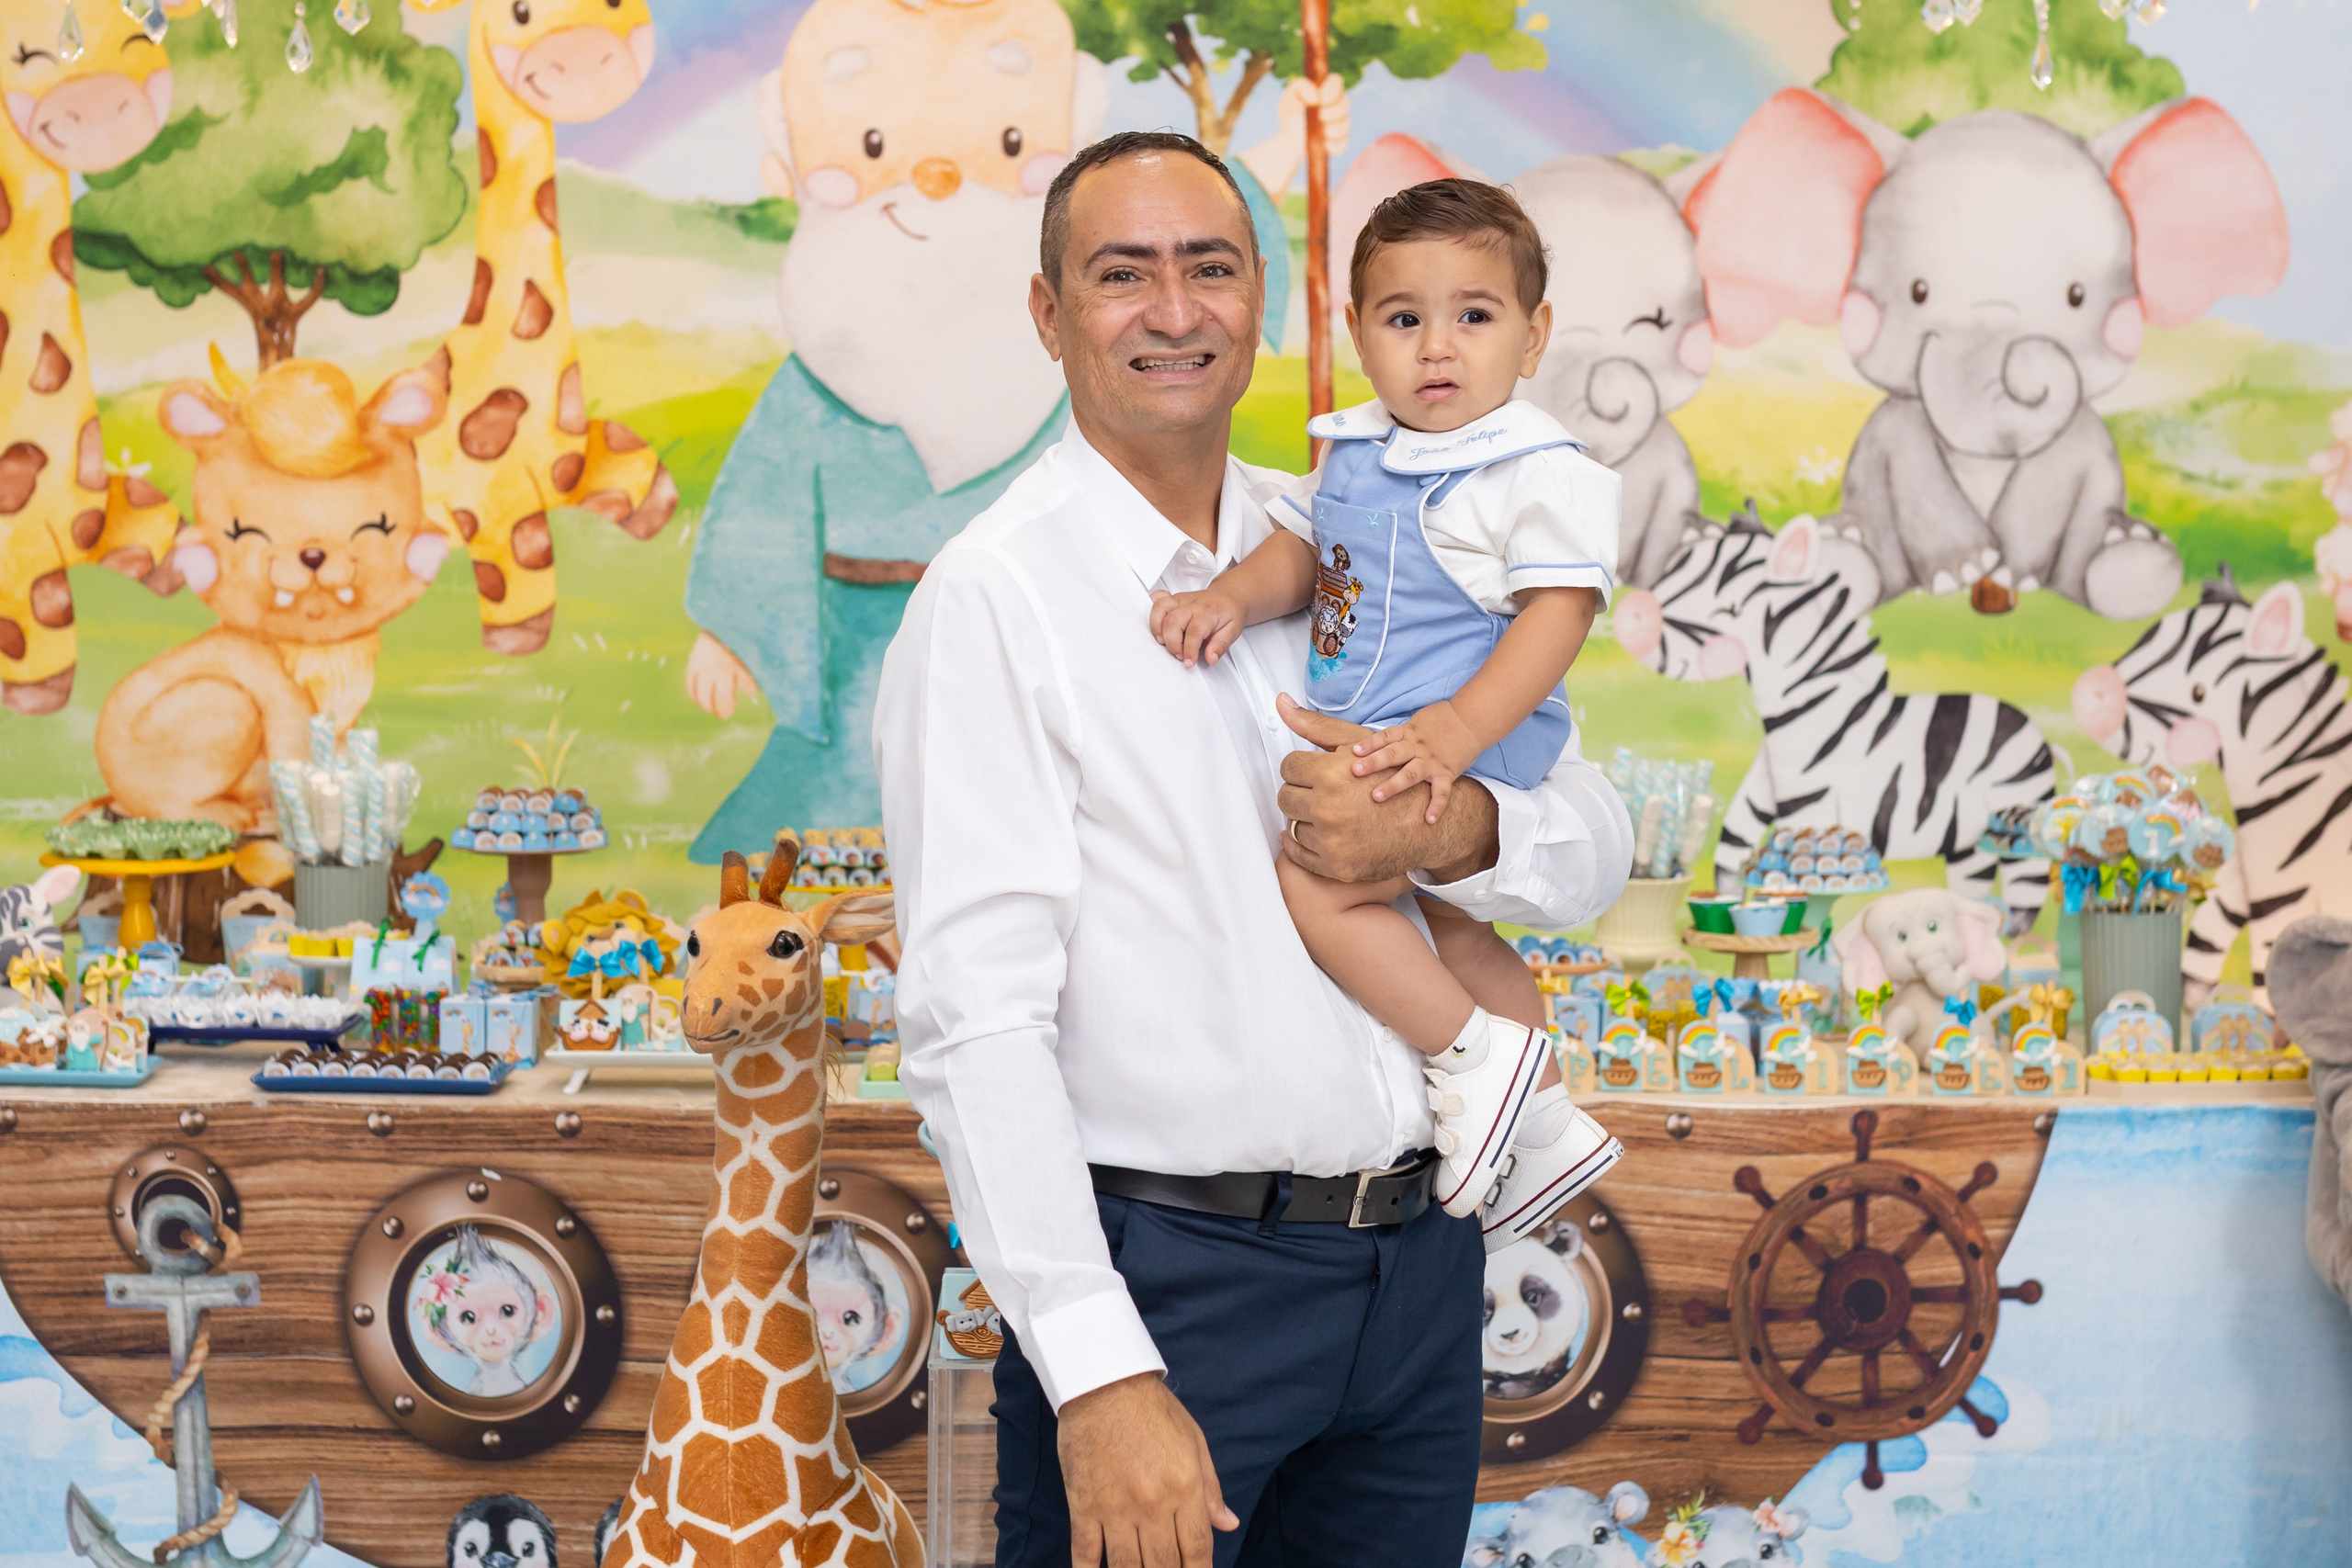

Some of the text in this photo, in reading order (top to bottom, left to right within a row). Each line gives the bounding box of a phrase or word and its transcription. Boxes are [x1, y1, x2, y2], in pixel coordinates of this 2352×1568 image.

[2144, 829, 2159, 858] 1
[1647, 1056, 1668, 1085] E
[1731, 1058, 1749, 1089] L
[2060, 1059, 2077, 1089] 1
